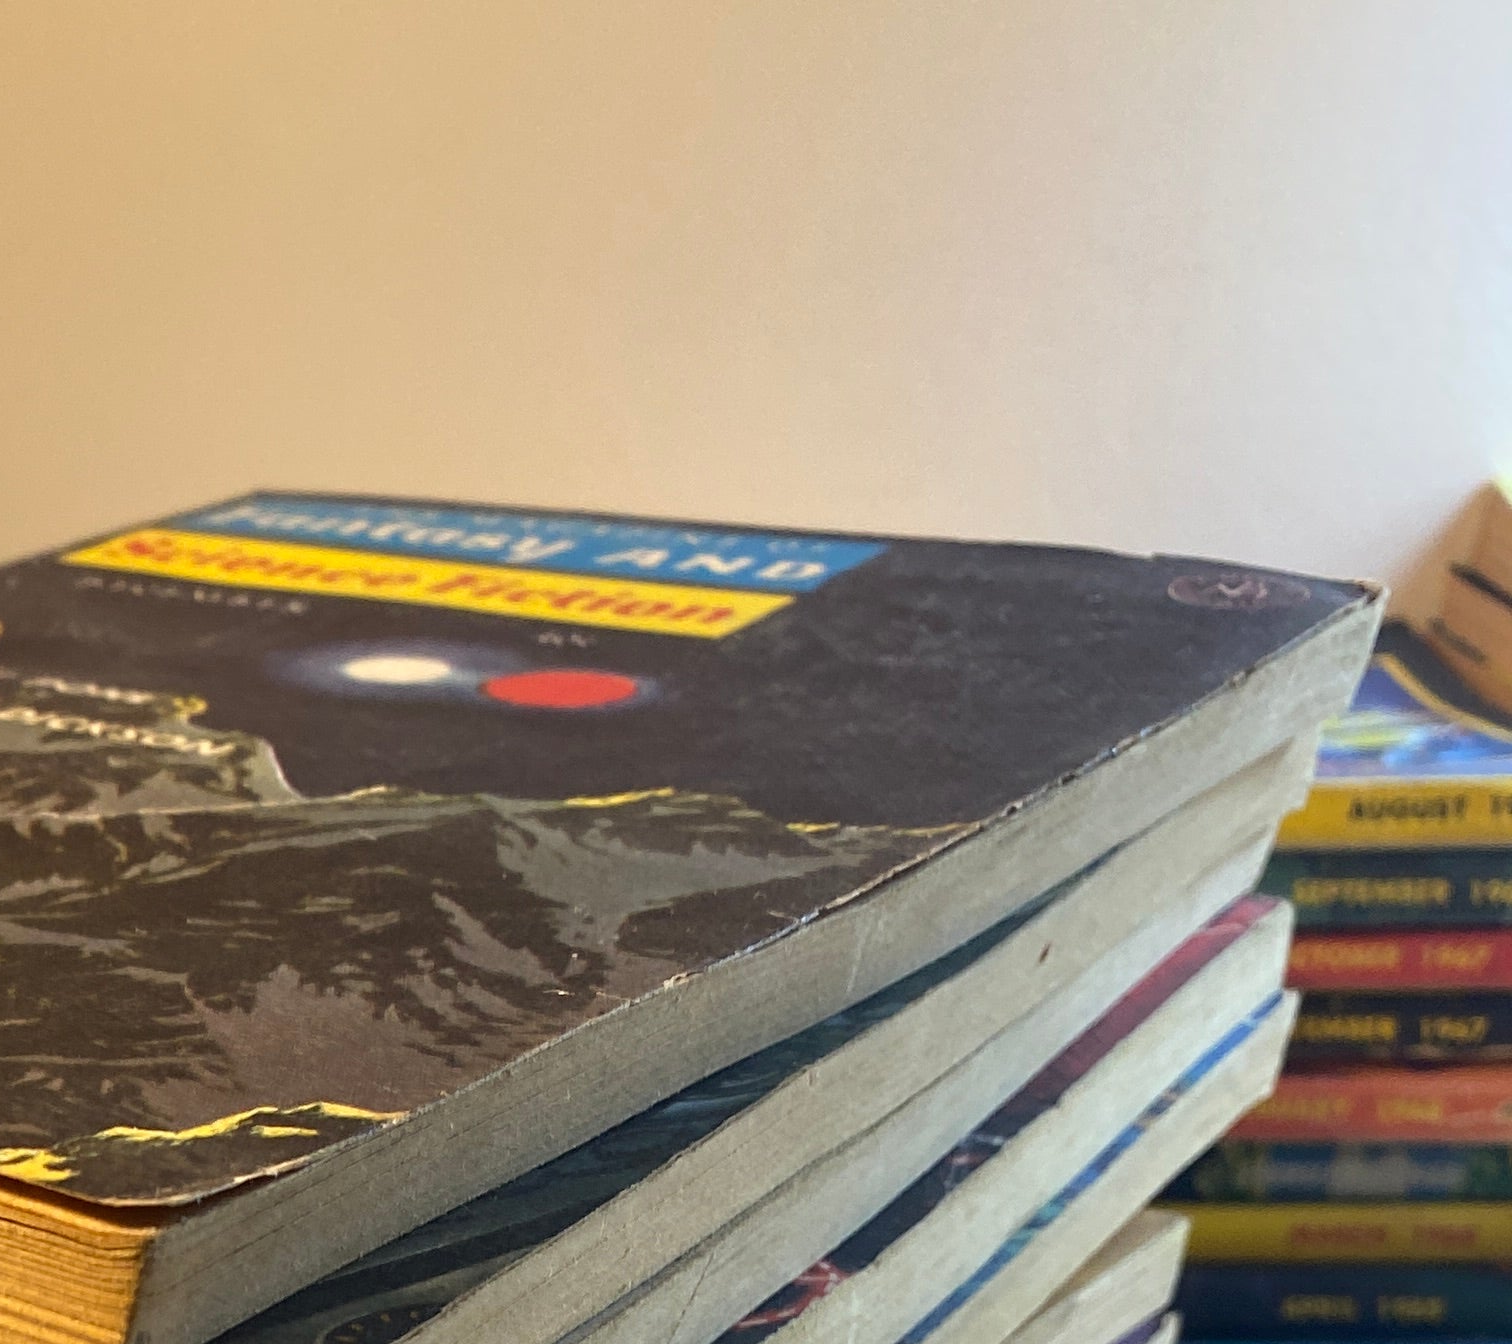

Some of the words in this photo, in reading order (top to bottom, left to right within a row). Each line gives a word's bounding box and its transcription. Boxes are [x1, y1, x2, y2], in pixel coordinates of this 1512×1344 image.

[204, 504, 576, 564] Fantasy
[593, 547, 829, 581] AND
[102, 537, 421, 588] Science
[425, 571, 737, 626] Fiction
[1349, 795, 1469, 822] AUGUST
